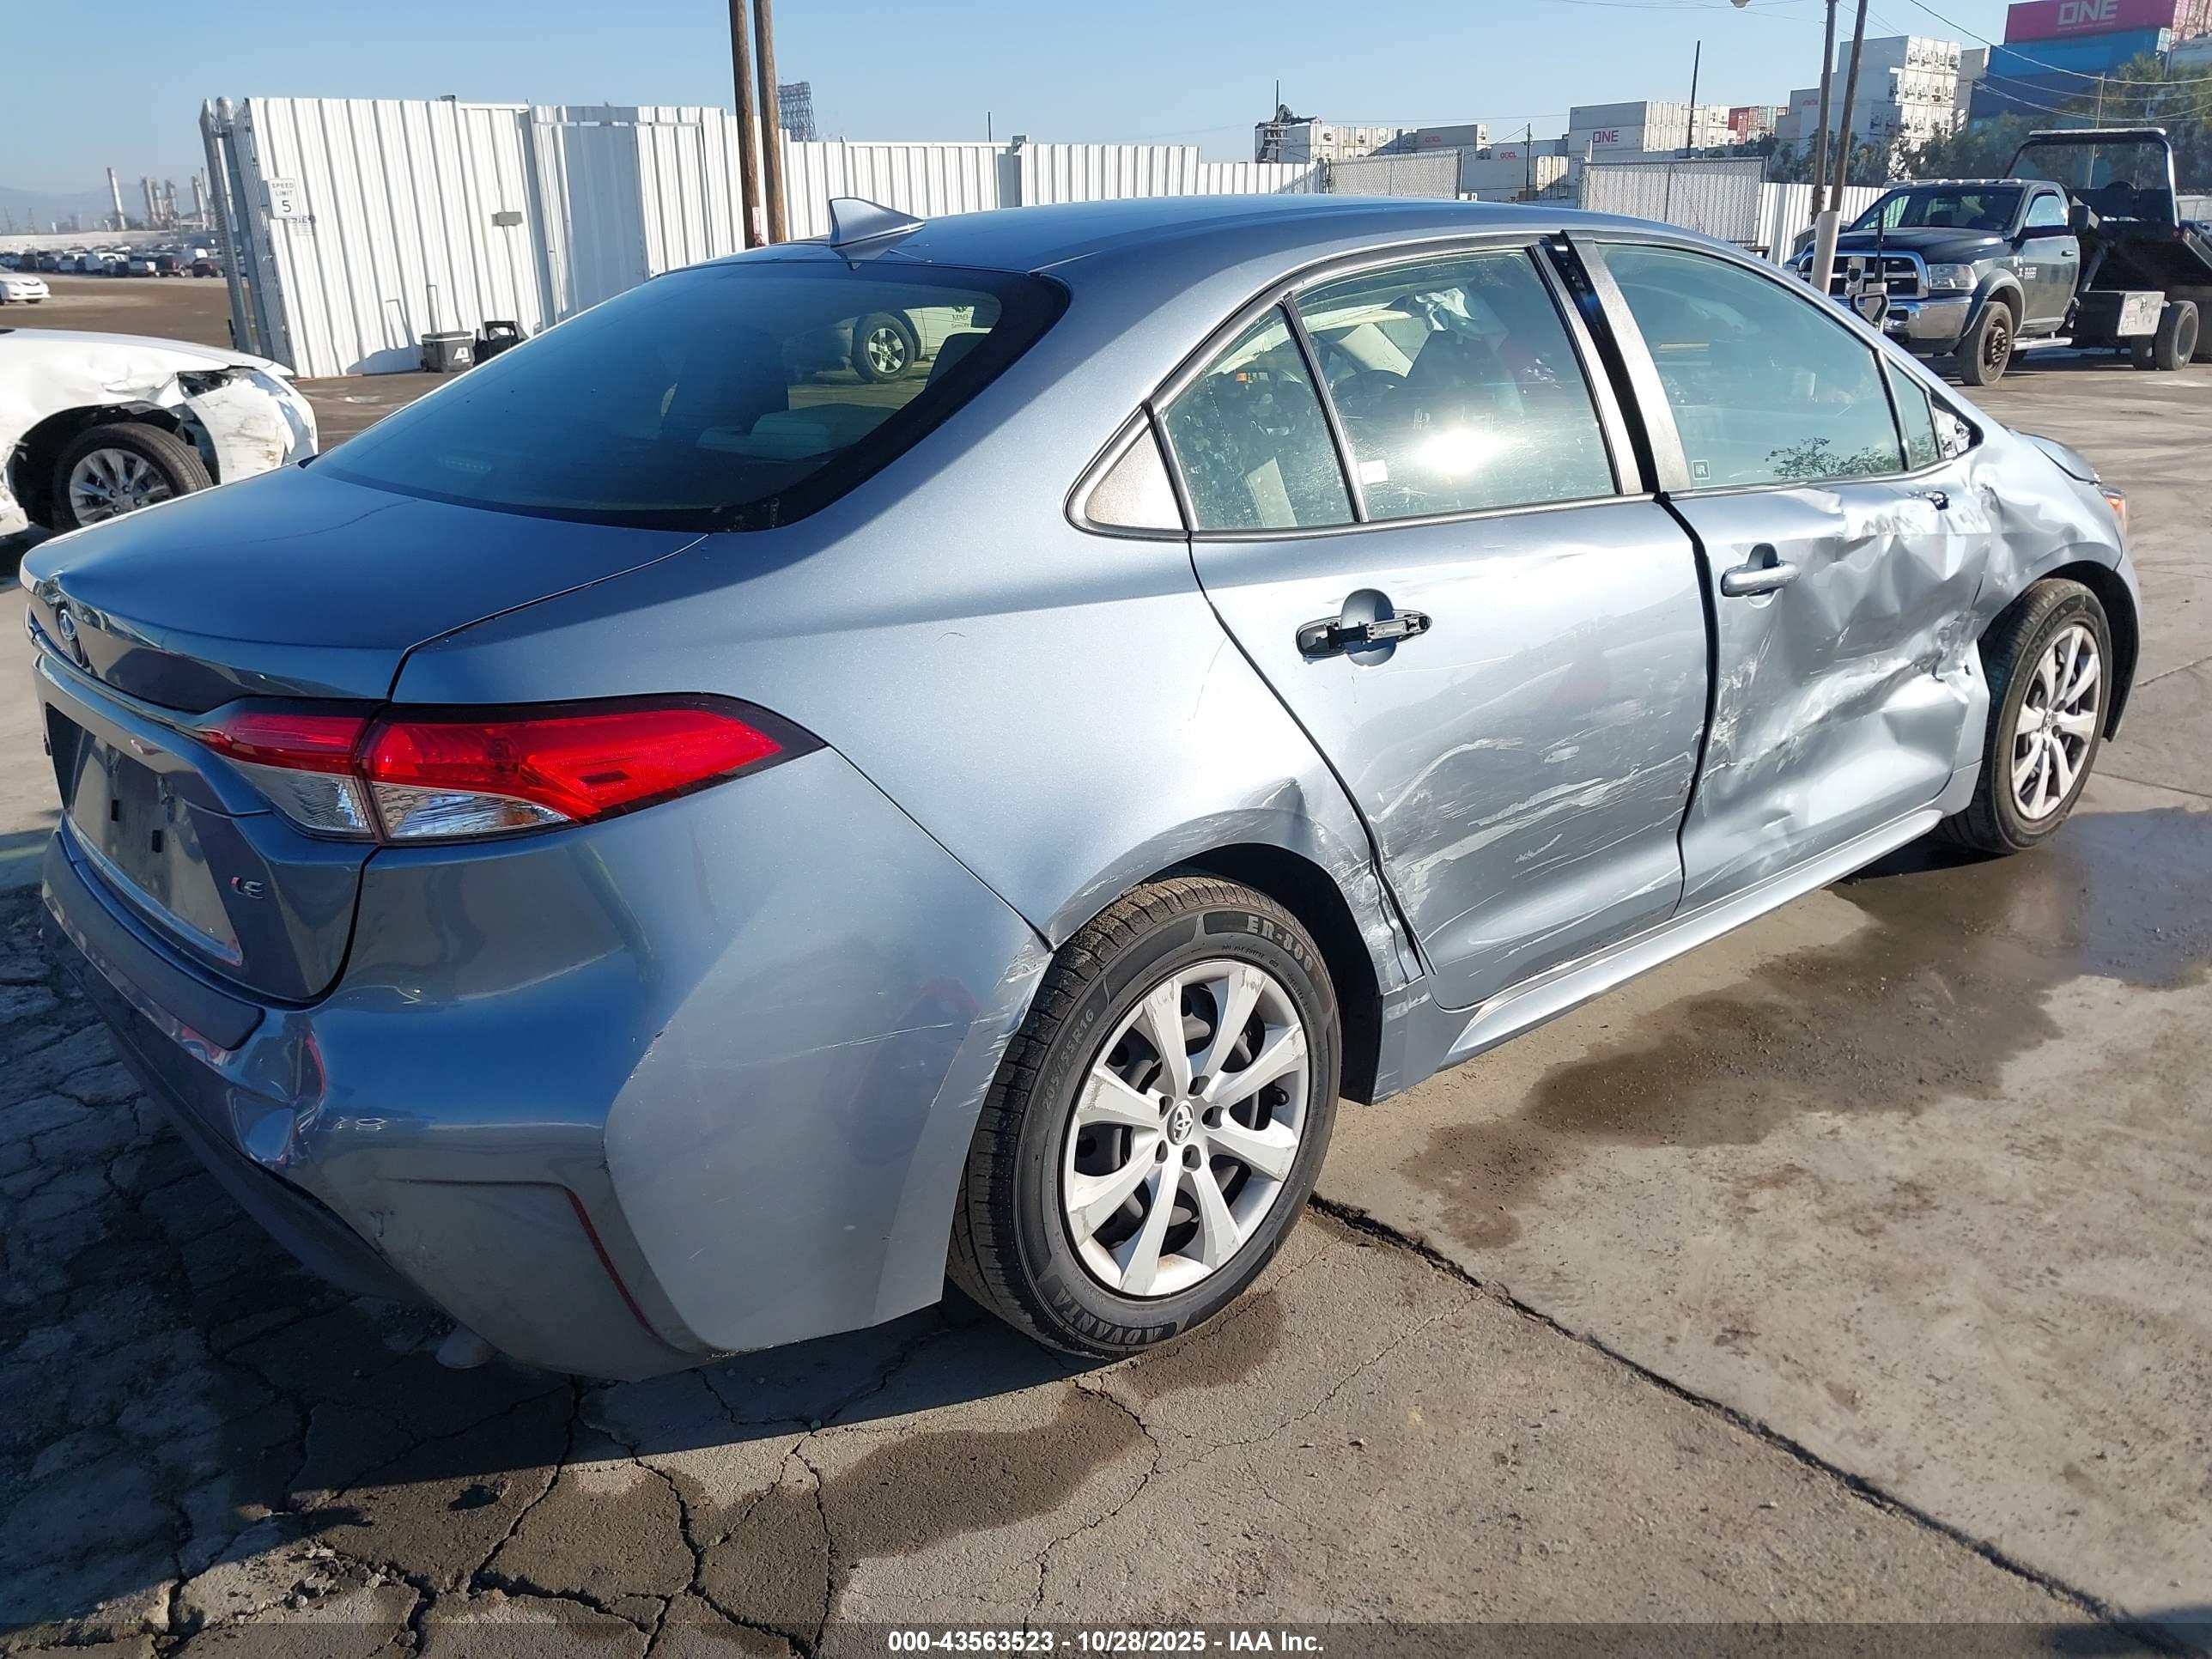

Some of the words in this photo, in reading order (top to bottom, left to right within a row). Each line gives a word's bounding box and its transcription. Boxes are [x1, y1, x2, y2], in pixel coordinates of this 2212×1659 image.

[2058, 0, 2118, 25] ONE
[1593, 131, 1619, 143] ONE
[282, 199, 292, 213] 5
[231, 876, 264, 899] LE
[1246, 914, 1314, 972] ER-800
[1051, 1286, 1165, 1346] ADVANTA
